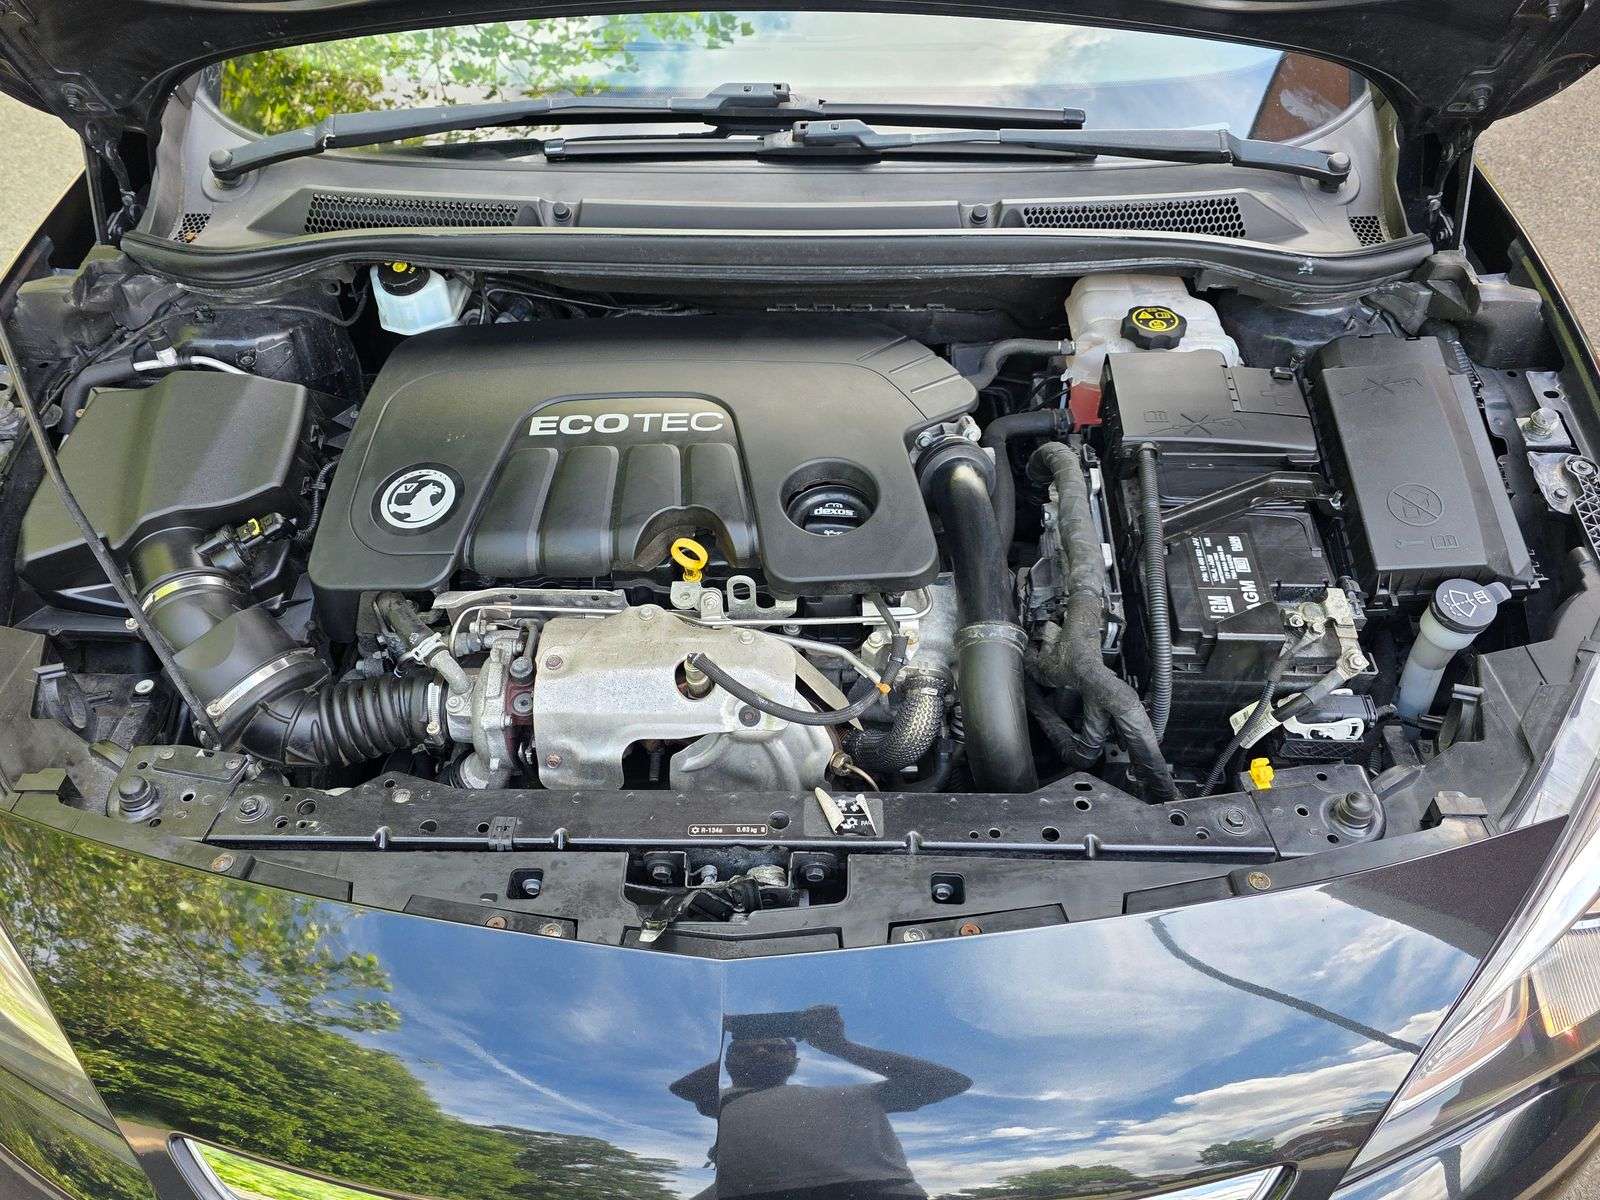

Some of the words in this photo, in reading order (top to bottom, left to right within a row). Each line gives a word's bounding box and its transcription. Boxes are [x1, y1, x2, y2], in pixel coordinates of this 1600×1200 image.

[529, 412, 724, 436] ECOTEC
[814, 507, 855, 516] dexos
[1208, 596, 1229, 613] GM
